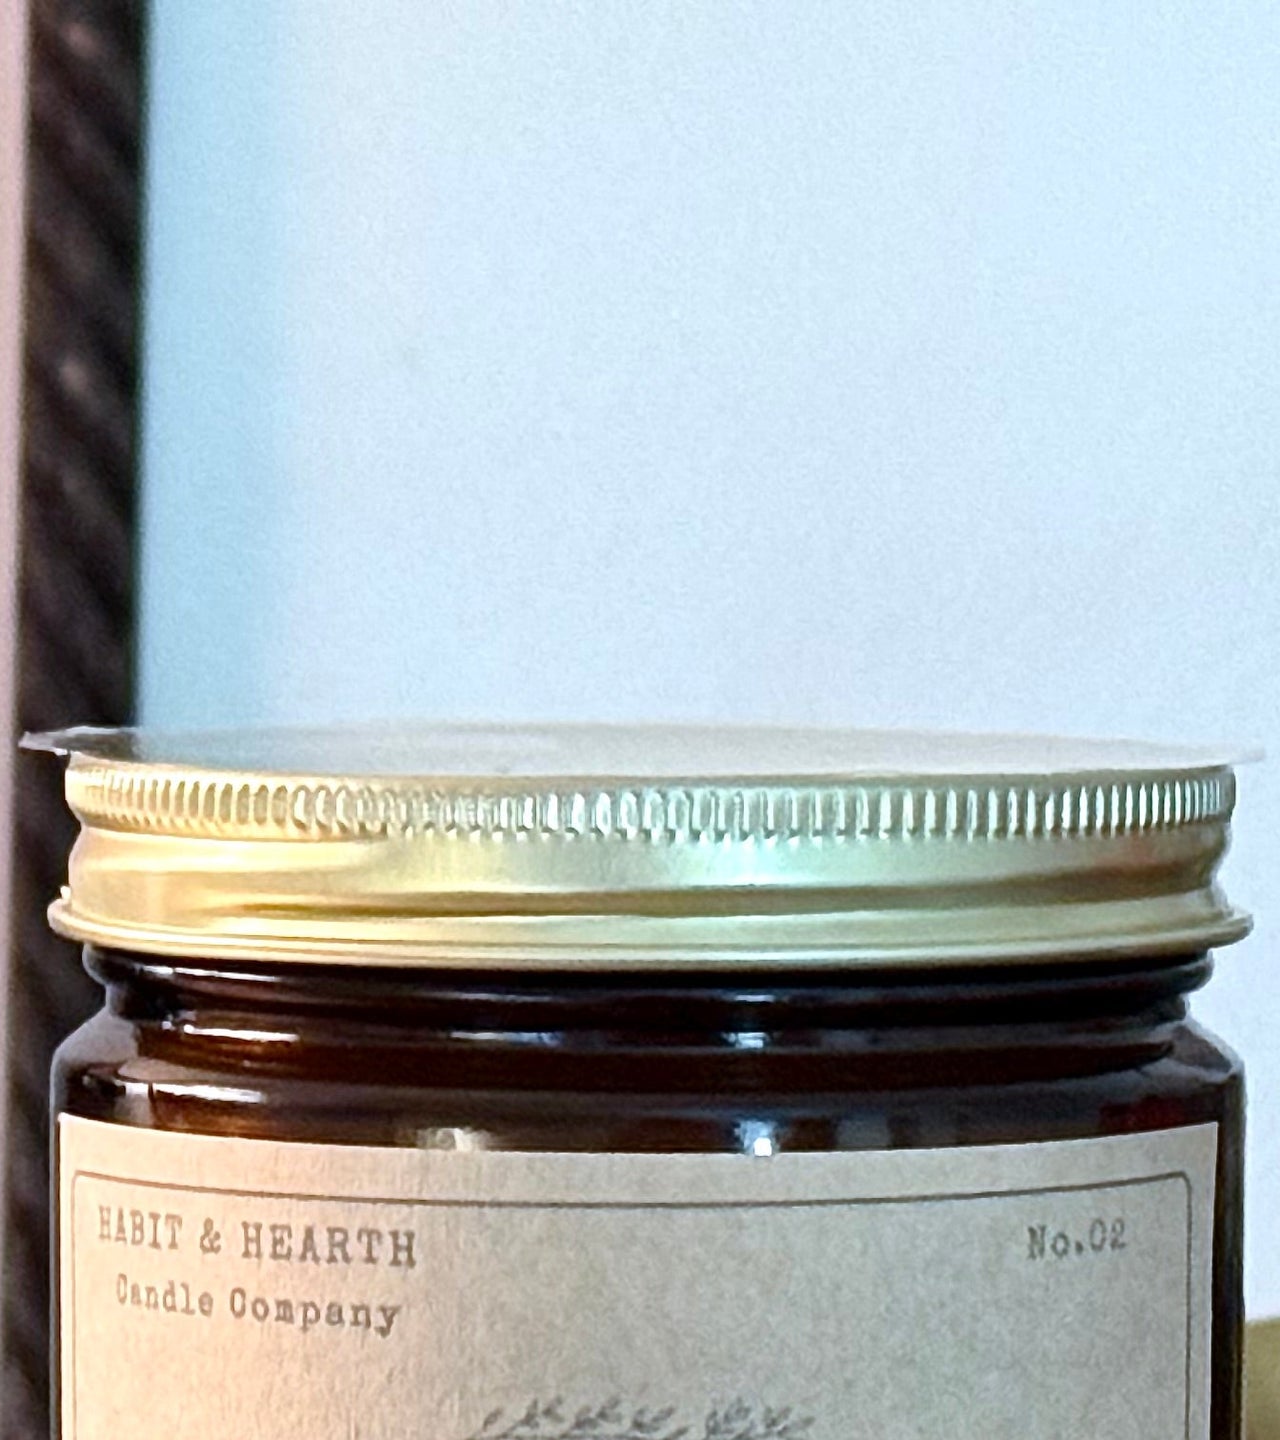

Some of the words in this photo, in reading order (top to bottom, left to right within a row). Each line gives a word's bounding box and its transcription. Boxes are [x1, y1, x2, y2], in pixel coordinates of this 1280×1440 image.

[98, 1205, 183, 1250] HABIT
[199, 1217, 221, 1255] &
[241, 1220, 417, 1268] HEARTH
[1027, 1218, 1127, 1260] No.02
[117, 1274, 213, 1316] Candle
[230, 1287, 401, 1337] Company
